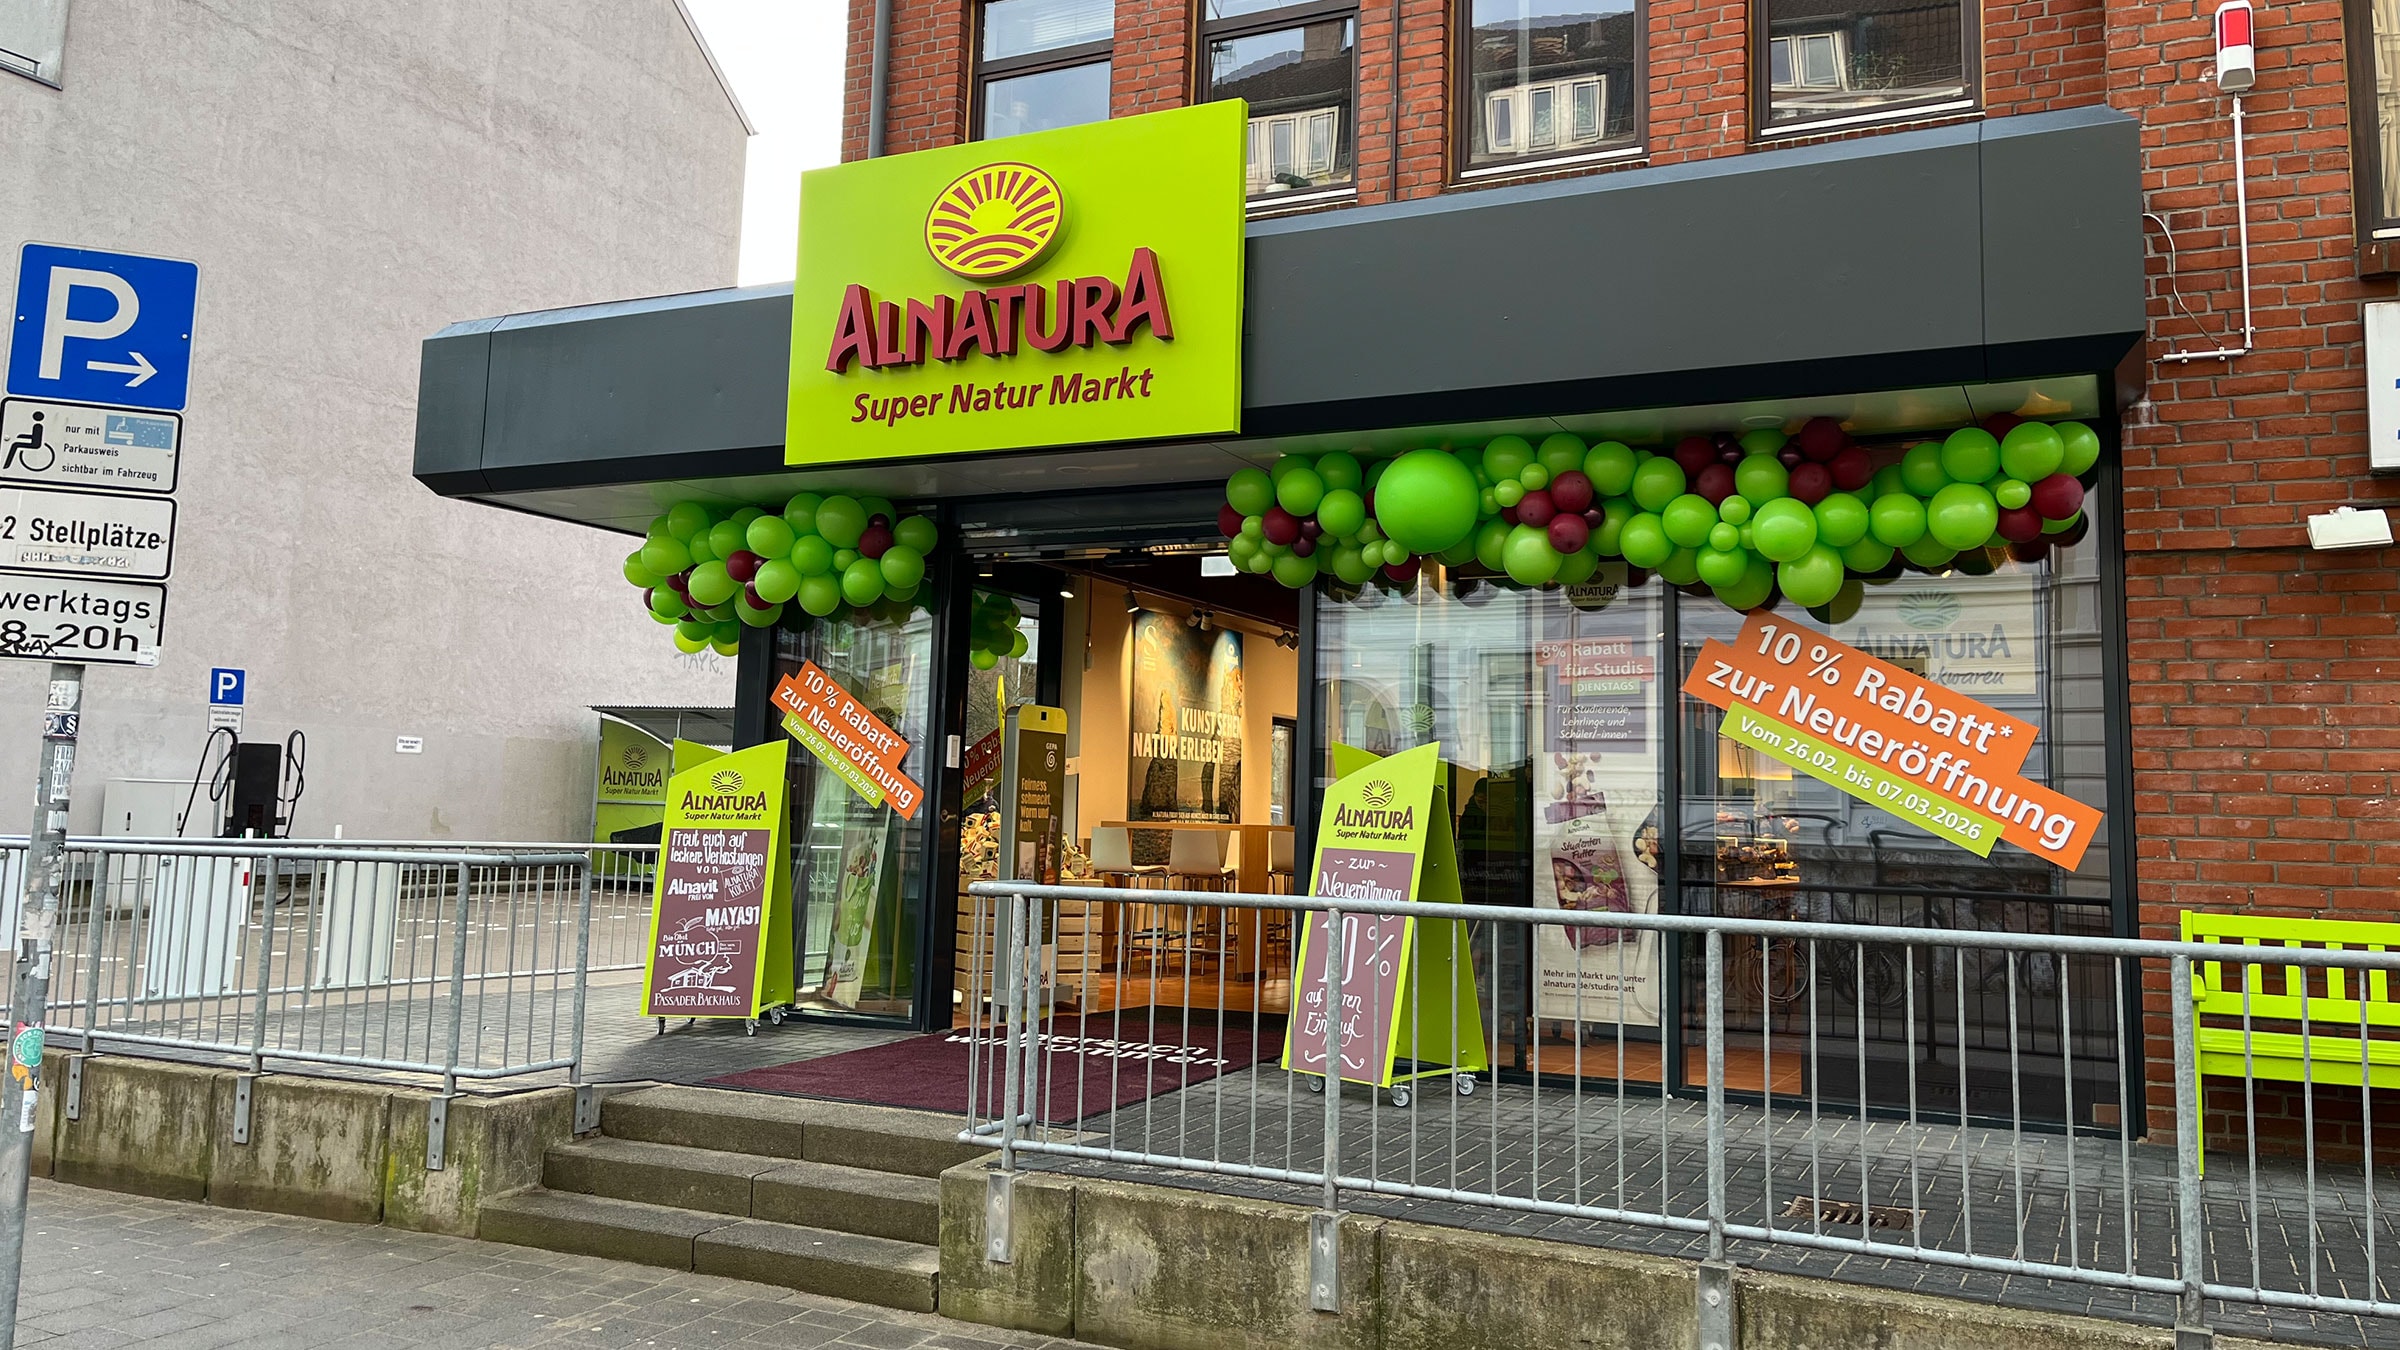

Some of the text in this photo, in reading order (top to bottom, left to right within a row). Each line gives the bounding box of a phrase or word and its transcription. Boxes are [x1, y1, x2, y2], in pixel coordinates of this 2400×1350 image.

[825, 247, 1175, 375] ALNATURA
[38, 265, 140, 381] P
[851, 366, 1154, 427] Super Natur Markt
[85, 426, 100, 435] mit
[63, 444, 119, 457] Parkausweis
[62, 464, 157, 481] sichtbar im Fahrzeug
[2, 515, 160, 551] 2 Stellplätze
[1568, 584, 1619, 596] ALNATURA
[0, 589, 150, 624] werktags
[1541, 641, 1626, 659] 8% Rabatt
[1854, 623, 2012, 660] ALNATURA
[1757, 624, 1801, 666] 10
[1809, 643, 1844, 687] %
[1565, 661, 1644, 677] für Studis
[217, 672, 238, 700] P
[804, 670, 824, 694] 10
[823, 685, 840, 708] %
[1577, 681, 1635, 692] DIENSTAGS
[1557, 704, 1632, 716] Für Studierende,
[1181, 707, 1242, 739] KUNST SEHEN
[1562, 716, 1626, 730] Lehrlinge und
[780, 685, 809, 712] zur
[807, 703, 914, 809] Neueröffnung
[1133, 732, 1224, 764] NATUR ERLEBEN
[1706, 660, 2076, 852] zur Neueröffnung
[789, 717, 878, 799] Vom 26.02. bis 07.03.2026
[603, 765, 663, 787] ALNATURA
[1021, 778, 1047, 791] Fairness
[1740, 715, 1983, 841] Vom 26.02. bis 07.03.2026
[605, 787, 659, 796] Super Natur Markt
[681, 790, 767, 811] ALNATURA
[684, 812, 709, 821] Super
[735, 812, 762, 820] Markt
[1021, 805, 1050, 819] Warm und
[1333, 803, 1414, 830] ALNATURA
[671, 829, 748, 851] Freut euch auf
[1336, 829, 1408, 841] Super Natur Markt
[670, 846, 764, 871] leckere Verkostungen
[1572, 848, 1597, 860] Futter
[696, 865, 719, 874] von
[1348, 858, 1375, 870] zur
[667, 878, 718, 895] Alnavit
[724, 867, 759, 888] ALNATURA
[687, 893, 701, 901] FREI
[728, 879, 756, 897] KOCHT
[1317, 871, 1402, 921] Neueröffnung
[705, 905, 760, 927] MAYA91
[663, 934, 674, 942] Bio
[659, 940, 716, 957] MÜNCH
[1364, 925, 1395, 976] %
[1543, 969, 1564, 978] Mehr
[1566, 970, 1576, 978] im
[1579, 971, 1603, 980] Markt
[1623, 974, 1646, 983] unter
[654, 992, 741, 1006] PASSADER BACKHAUS
